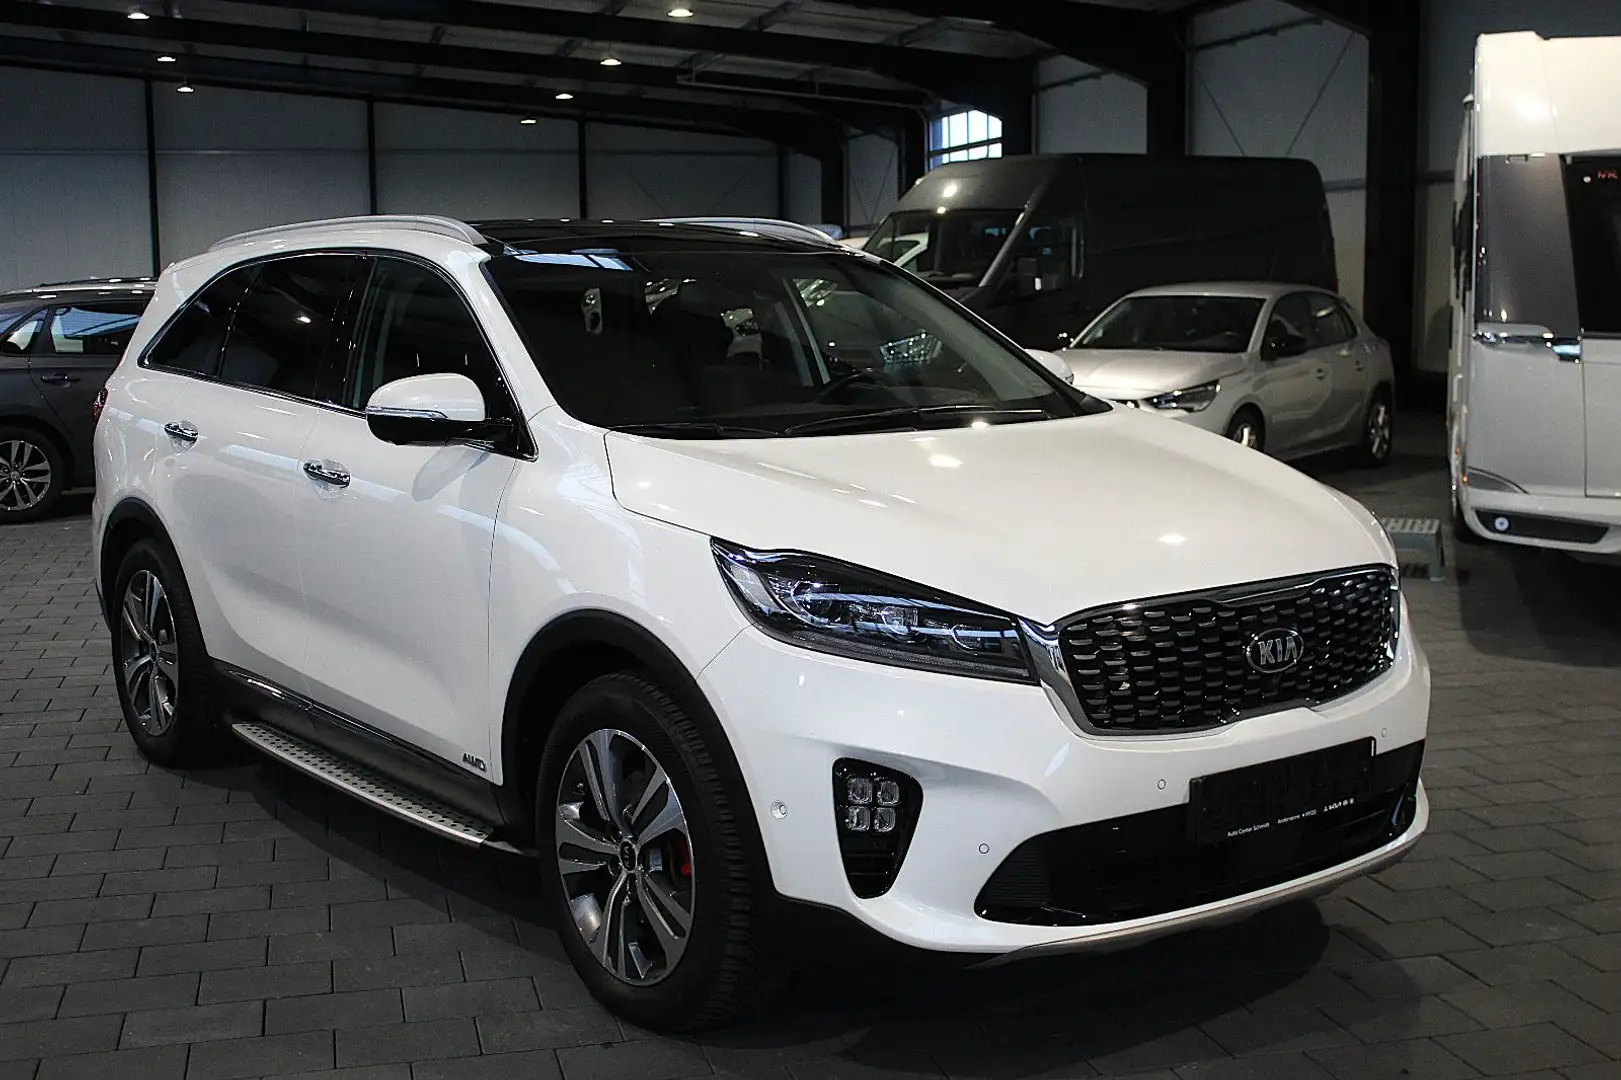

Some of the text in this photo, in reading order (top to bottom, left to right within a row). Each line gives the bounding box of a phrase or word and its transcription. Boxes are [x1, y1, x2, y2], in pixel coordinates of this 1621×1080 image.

[1257, 636, 1298, 665] KIA
[463, 752, 486, 772] AWD
[1253, 822, 1269, 830] Schmidt
